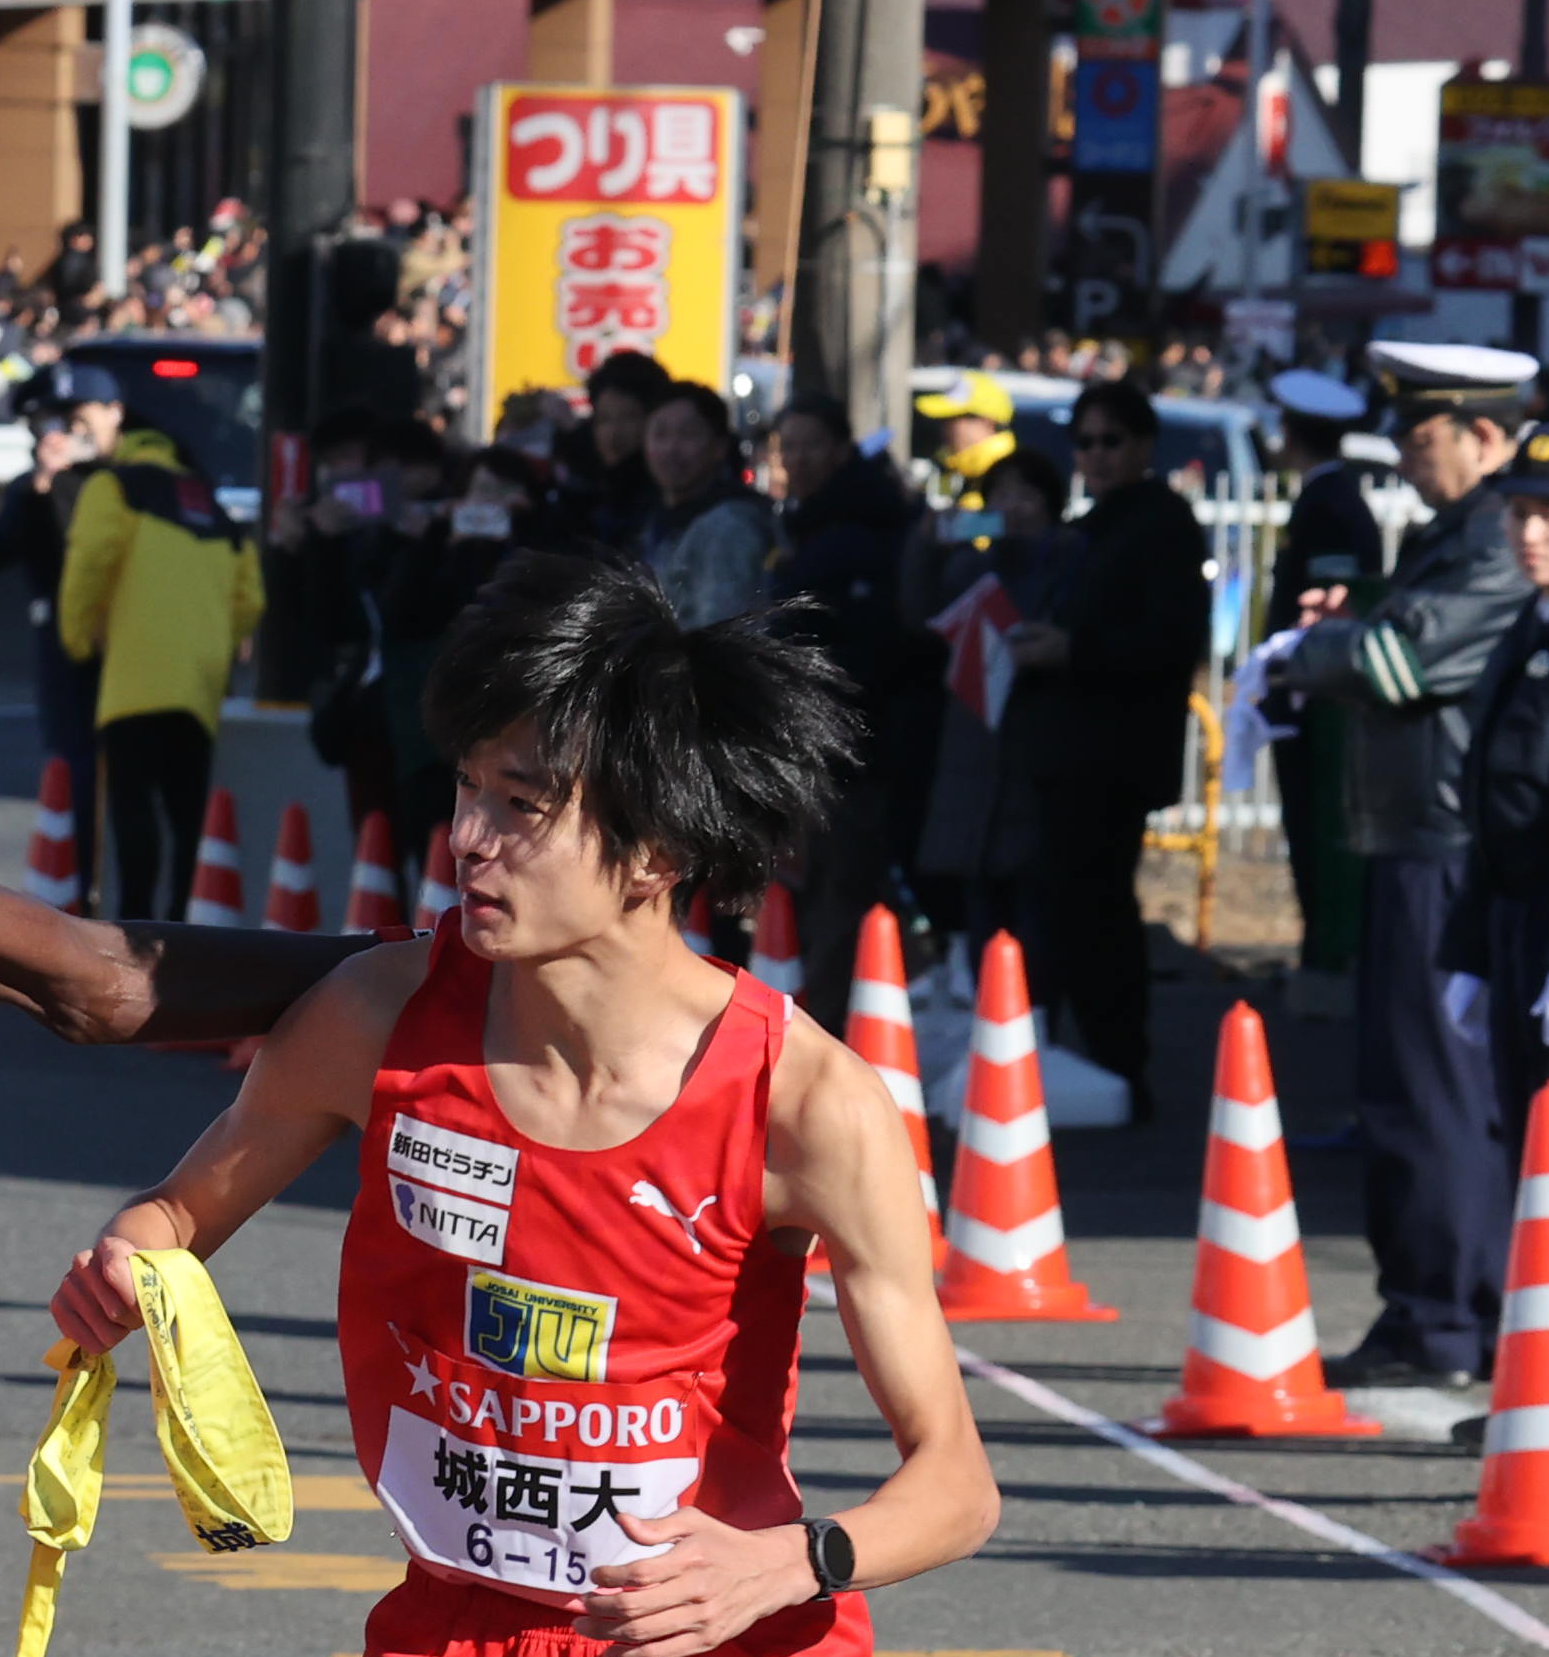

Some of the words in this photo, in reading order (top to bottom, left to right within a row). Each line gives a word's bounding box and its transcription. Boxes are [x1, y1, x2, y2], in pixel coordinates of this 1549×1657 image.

[511, 104, 717, 200] つり具
[392, 1131, 513, 1187] 新田ゼラチン
[419, 1202, 500, 1247] NITTA
[485, 1281, 520, 1299] JOSAI
[523, 1292, 600, 1317] UNIVERSITY
[478, 1295, 598, 1382] JU
[448, 1380, 684, 1448] SAPPORO
[433, 1436, 642, 1533] 城西大
